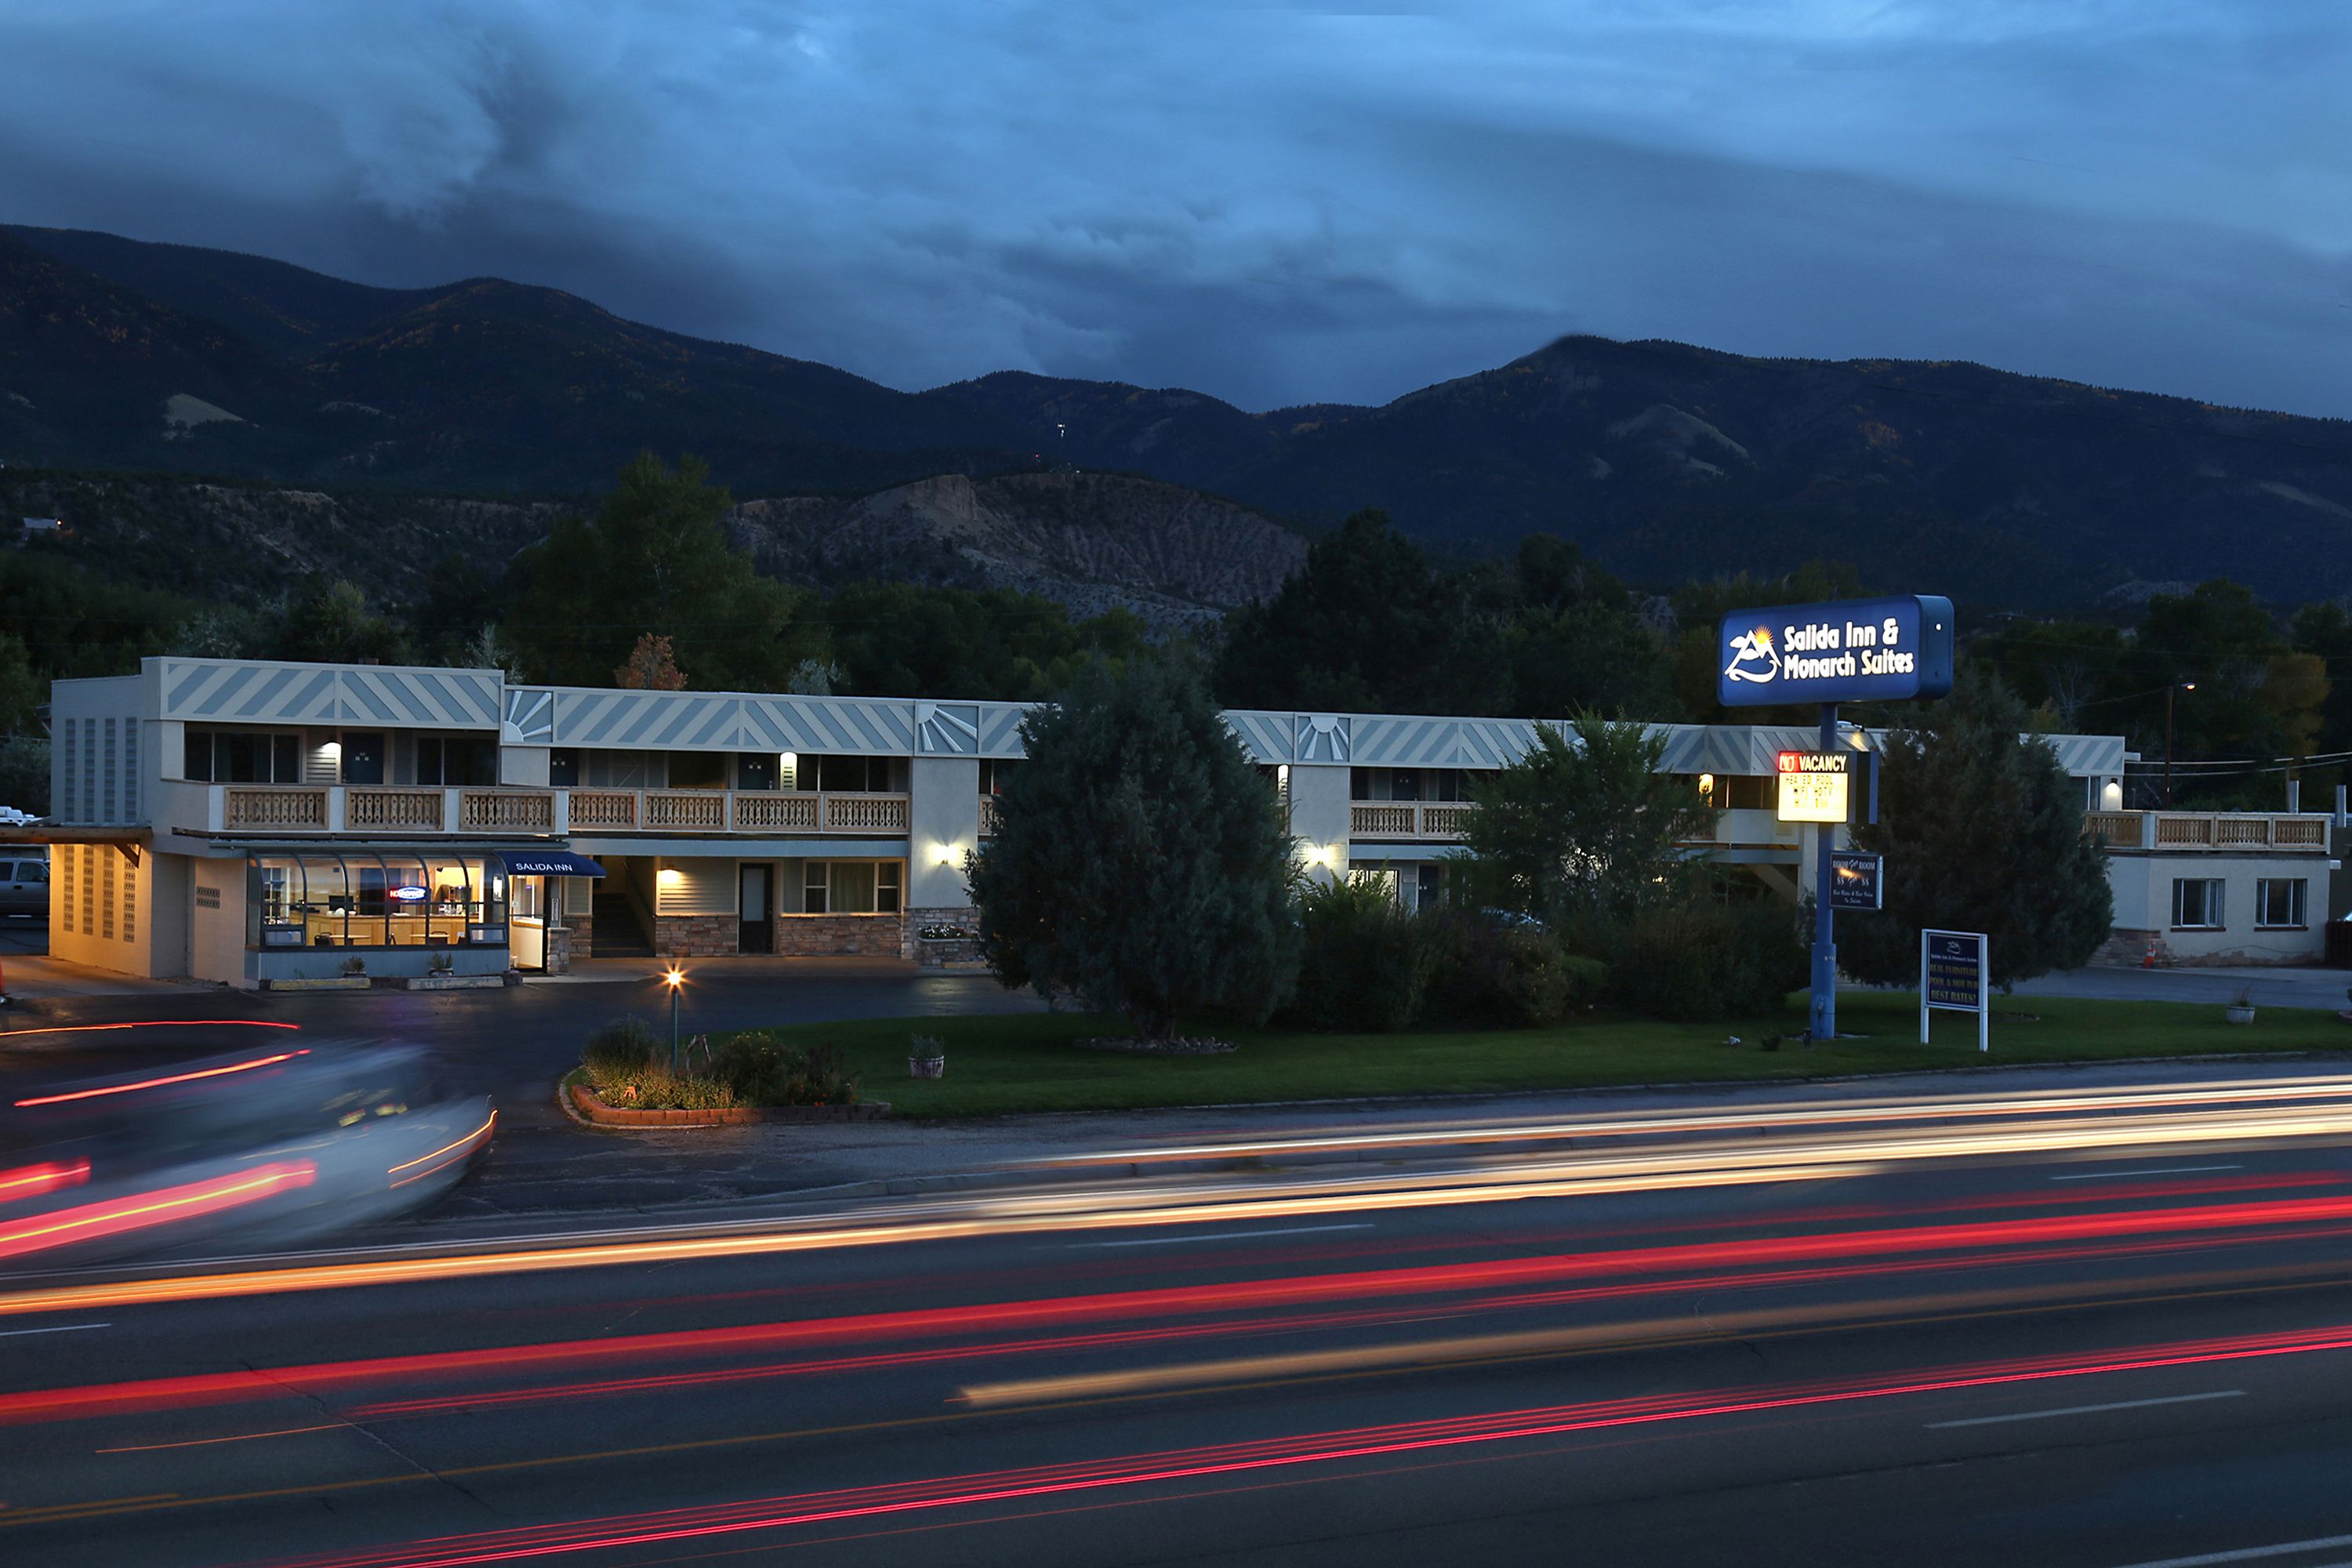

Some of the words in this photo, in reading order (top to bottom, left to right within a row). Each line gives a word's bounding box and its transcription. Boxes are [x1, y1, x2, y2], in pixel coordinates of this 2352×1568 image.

[1784, 623, 1839, 652] Salida
[1846, 622, 1876, 648] Inn
[1882, 618, 1898, 644] &
[1784, 651, 1856, 680] Monarch
[1861, 648, 1914, 675] Suites
[1780, 755, 1795, 771] NO
[1798, 755, 1846, 771] VACANCY
[1833, 860, 1849, 869] ROOM
[1931, 989, 1948, 1000] BEST
